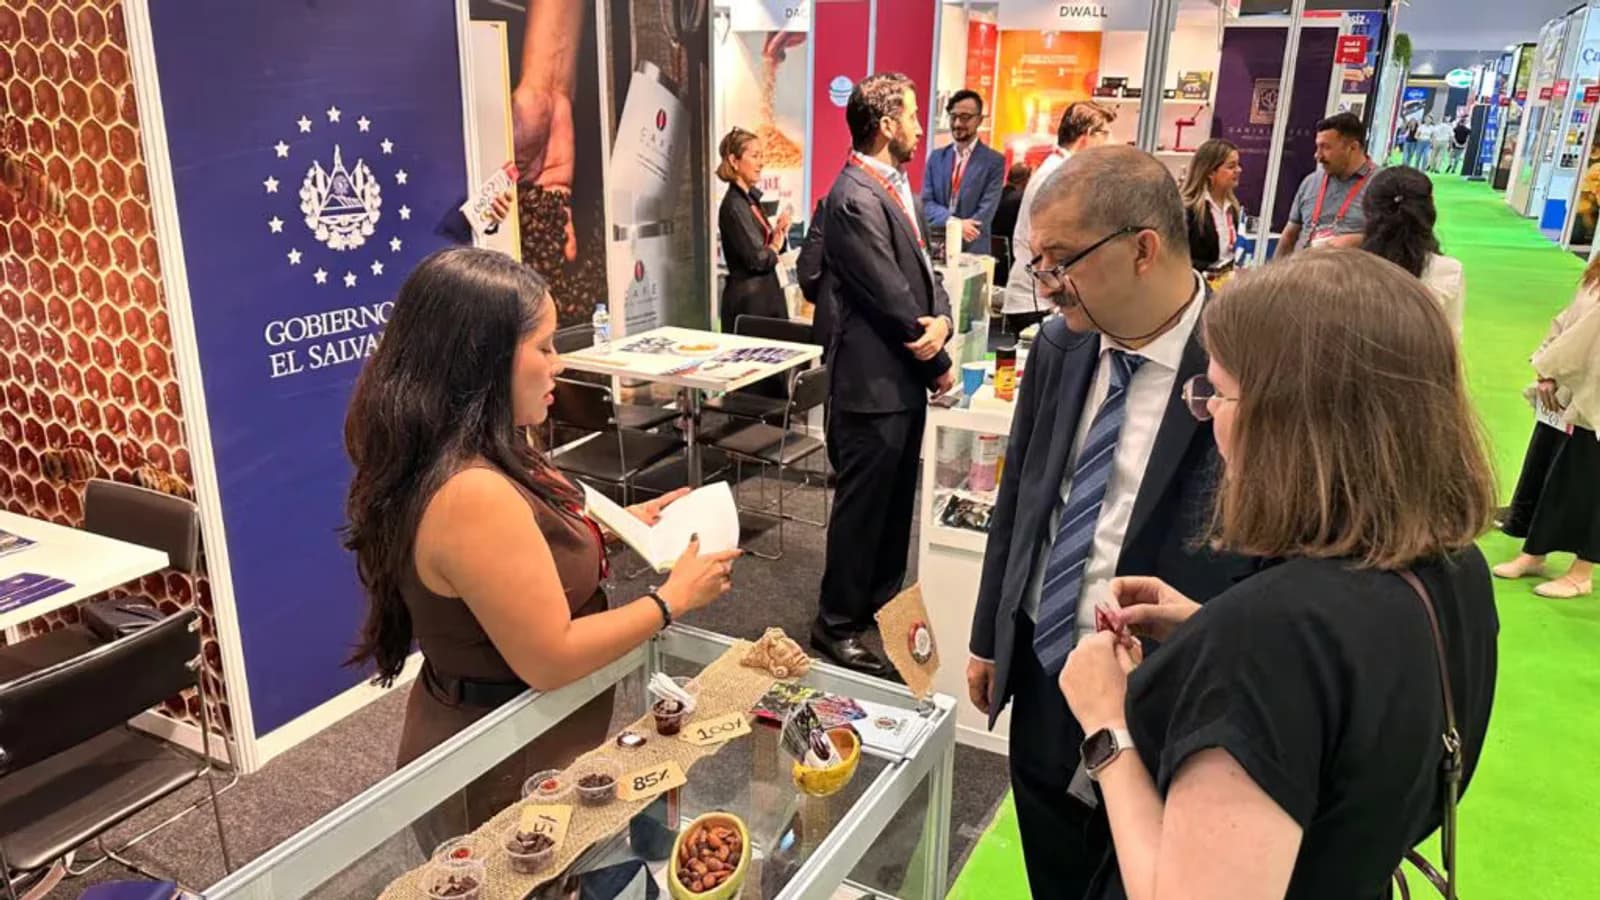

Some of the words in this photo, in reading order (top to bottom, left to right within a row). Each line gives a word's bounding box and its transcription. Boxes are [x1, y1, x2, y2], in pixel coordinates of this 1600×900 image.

[1059, 6, 1108, 18] DWALL
[269, 350, 304, 378] EL
[308, 331, 386, 369] SALVA
[696, 717, 742, 741] 100%
[633, 768, 670, 791] 85%
